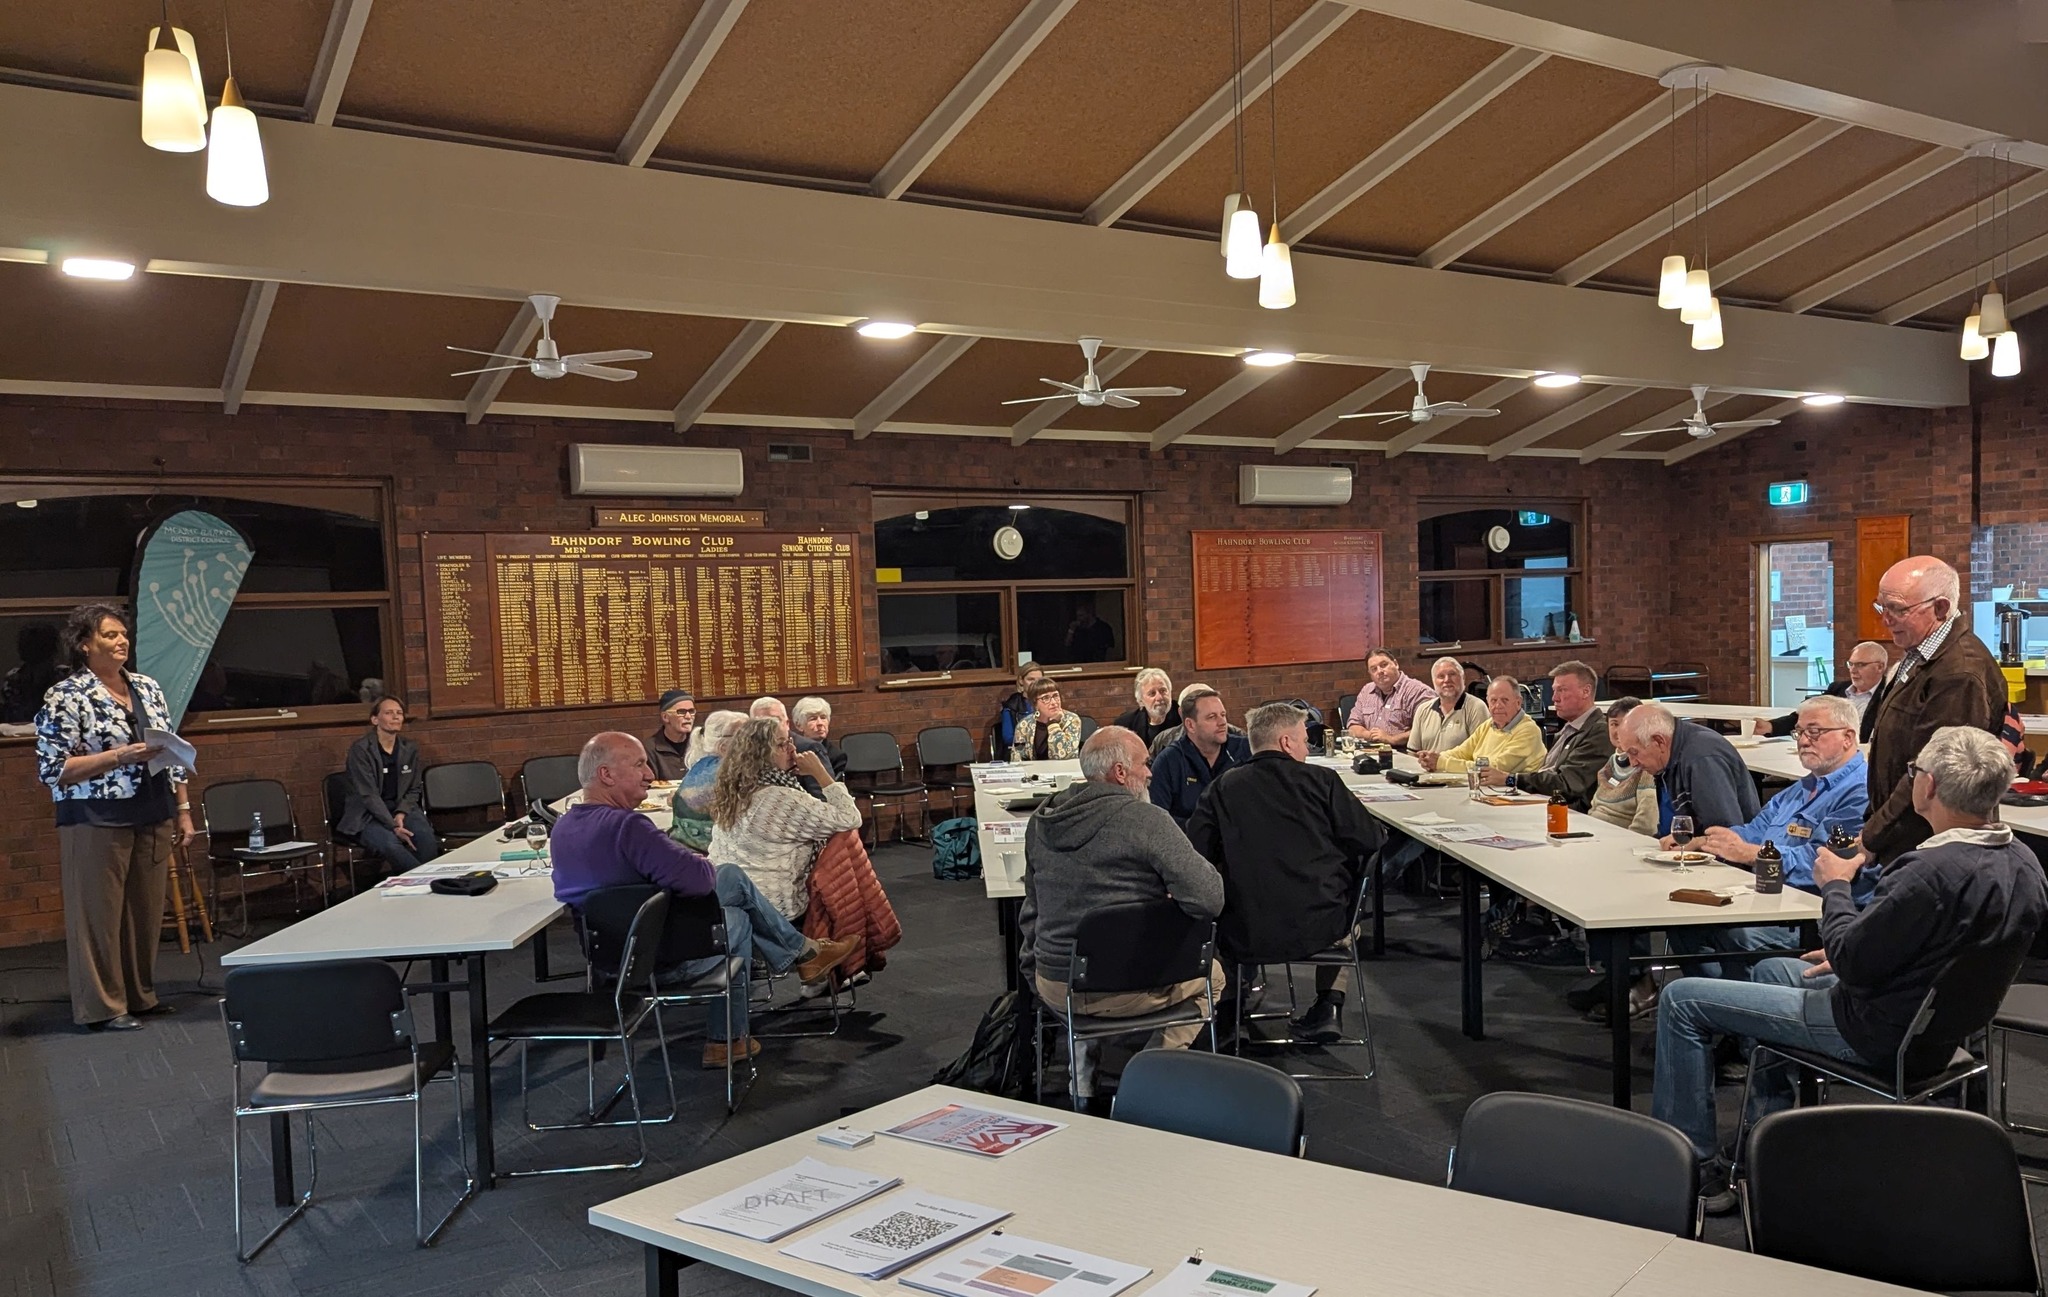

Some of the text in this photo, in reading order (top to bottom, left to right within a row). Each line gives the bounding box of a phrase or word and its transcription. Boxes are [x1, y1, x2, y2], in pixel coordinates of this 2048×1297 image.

[619, 513, 746, 523] ALEC JOHNSTON MEMORIAL
[201, 536, 231, 544] COUNCIL
[550, 536, 734, 546] HAHNDORF BOWLING CLUB
[797, 536, 833, 544] HAHNDORF
[1217, 537, 1311, 546] HAHNDORF BOWLING CLUB
[781, 544, 850, 552] SENIOR CITIZENS CLUB
[744, 1188, 829, 1210] DRAFT
[1210, 1277, 1237, 1287] WORK
[1239, 1283, 1268, 1292] FLOW
